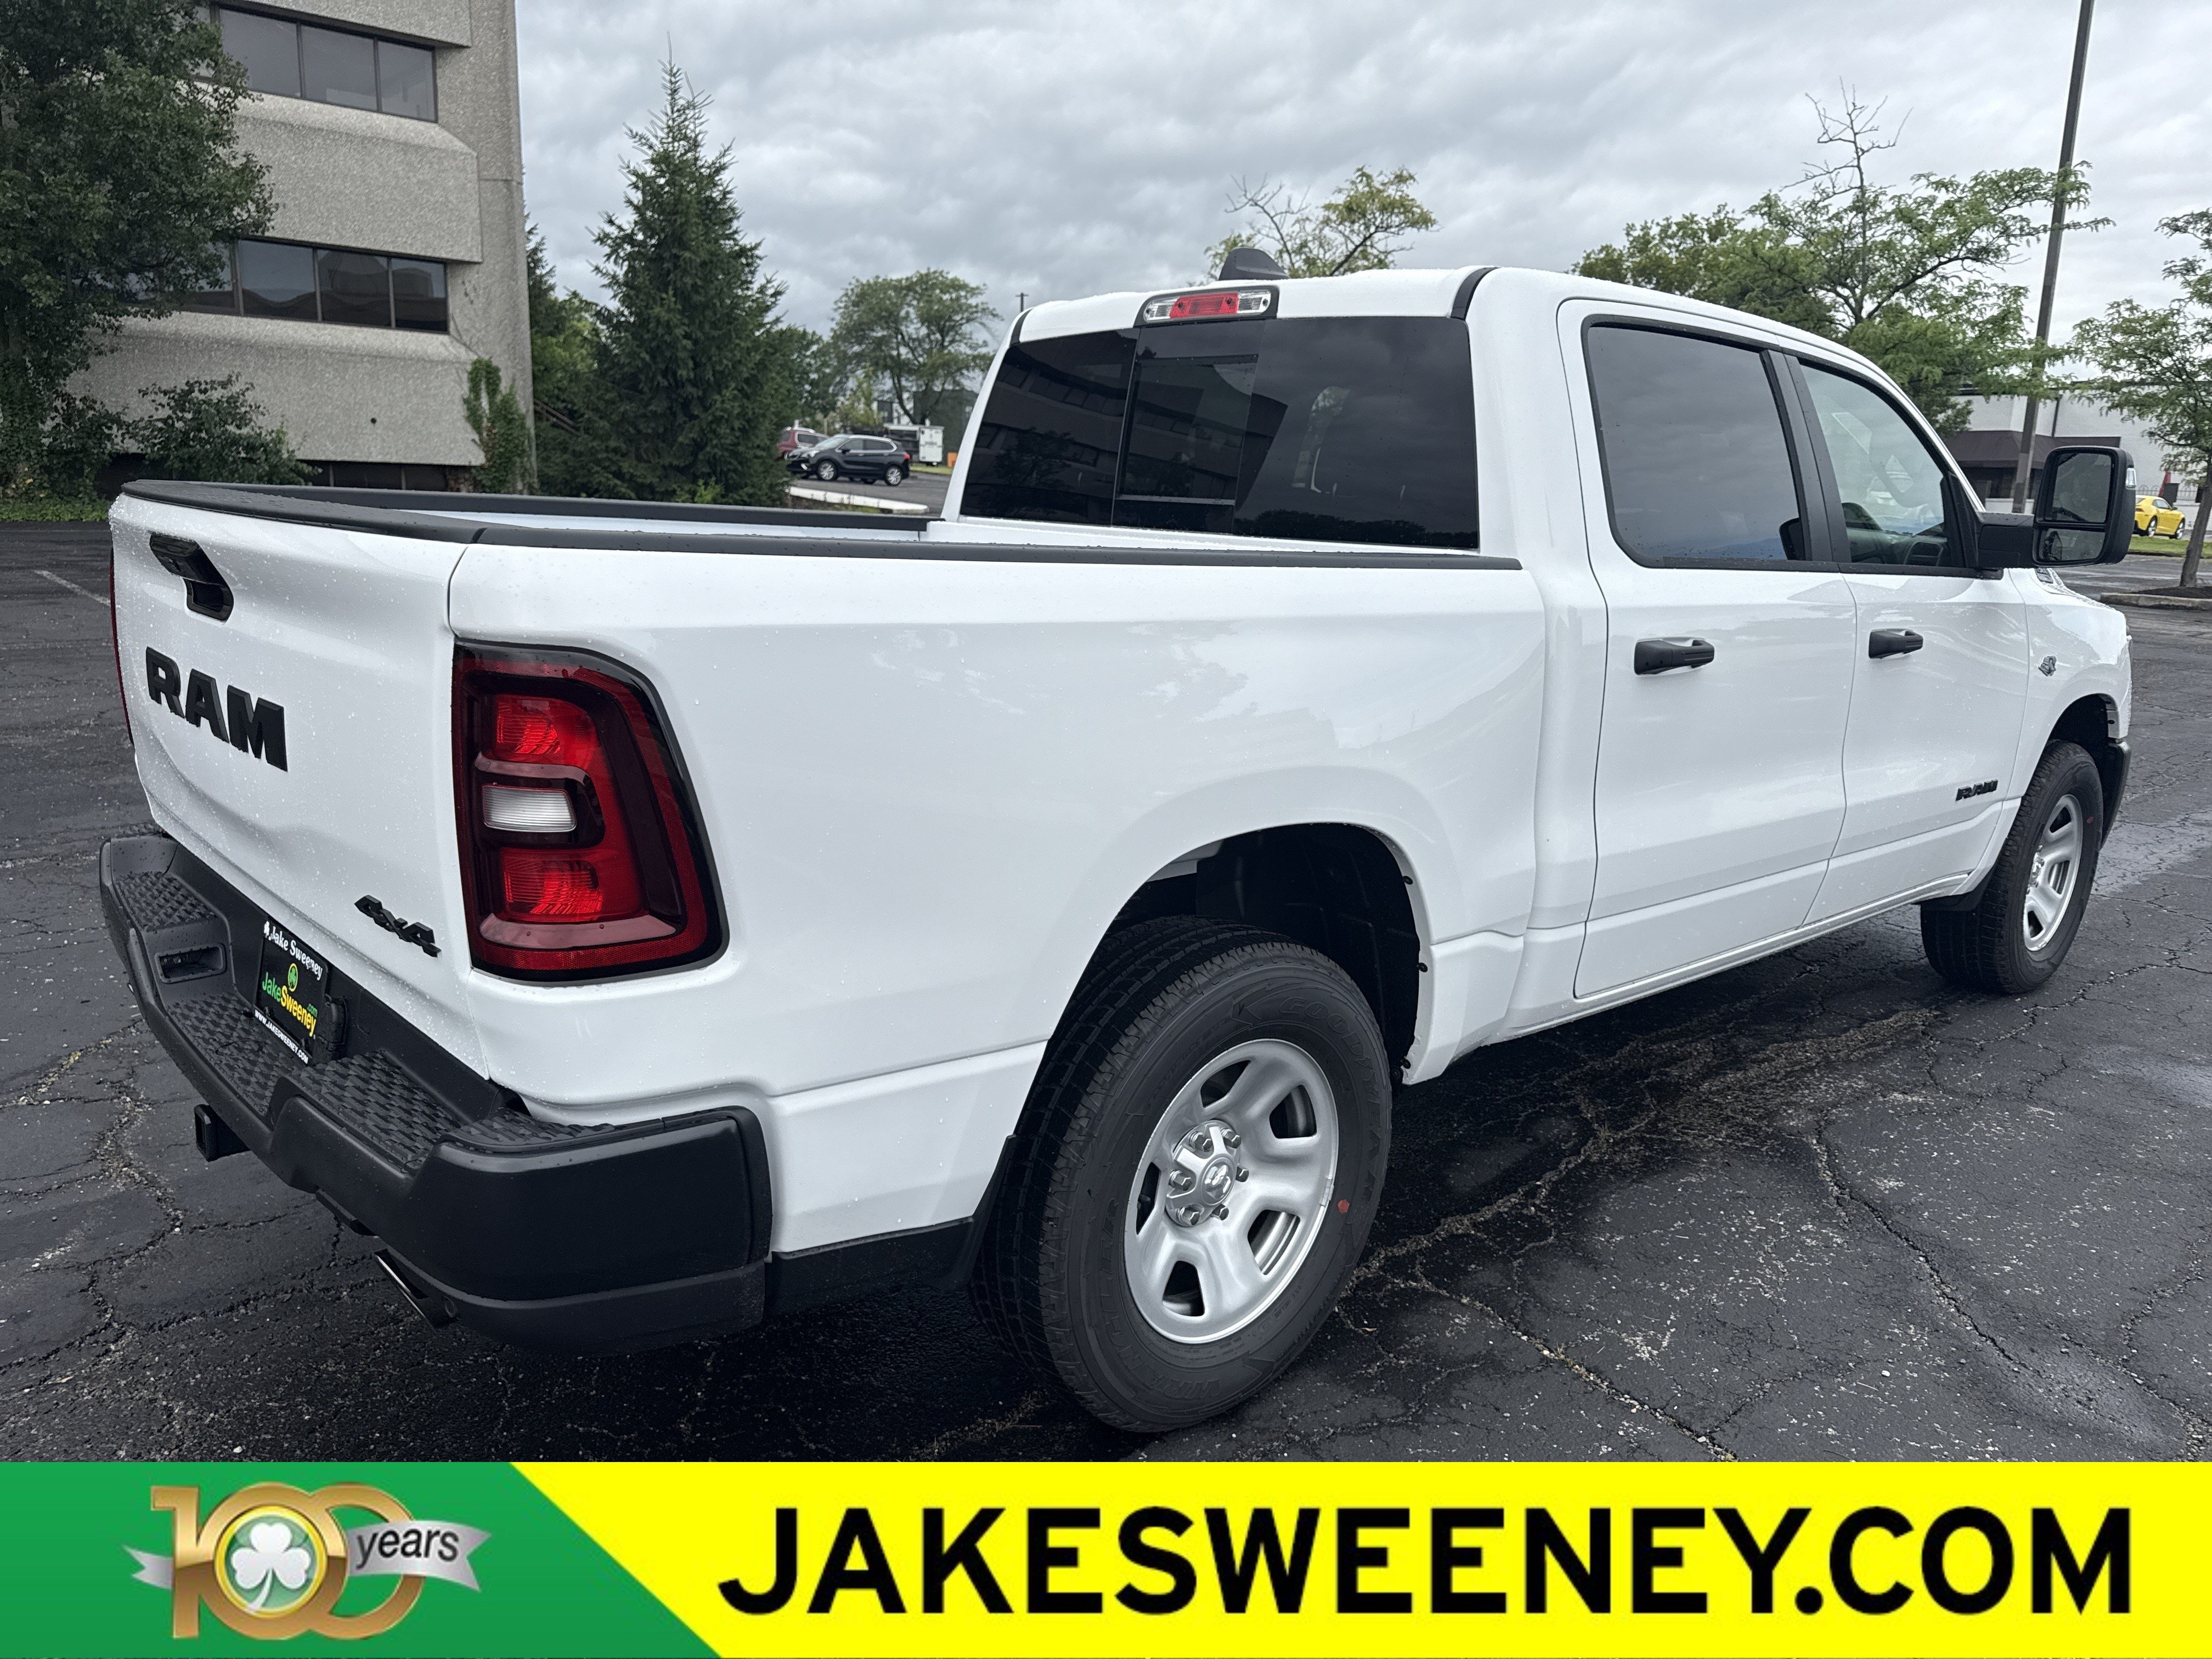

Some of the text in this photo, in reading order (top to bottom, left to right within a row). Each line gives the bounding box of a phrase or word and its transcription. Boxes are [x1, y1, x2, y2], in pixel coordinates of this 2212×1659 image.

[146, 646, 287, 771] RAM
[1955, 779, 1999, 802] RAM
[269, 926, 323, 980] Jake Sweeney
[255, 1009, 309, 1064] WWW.JAKESWEENEY.COM
